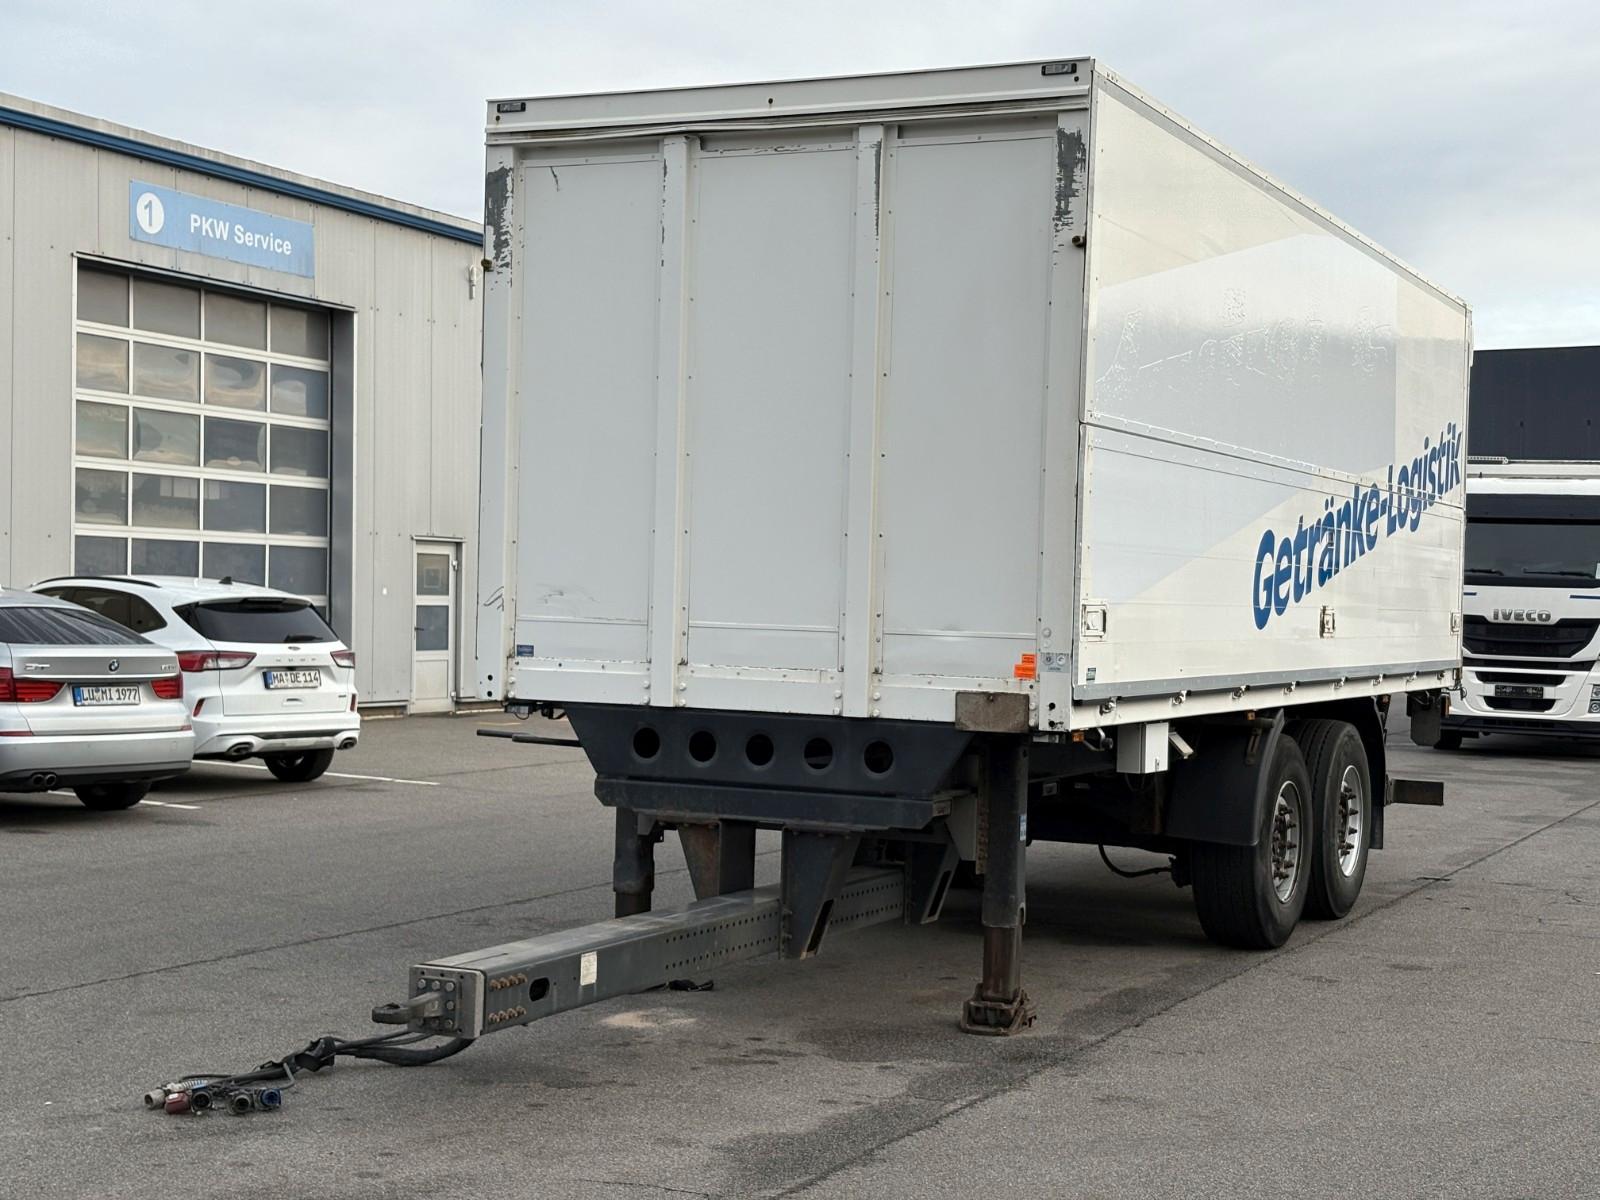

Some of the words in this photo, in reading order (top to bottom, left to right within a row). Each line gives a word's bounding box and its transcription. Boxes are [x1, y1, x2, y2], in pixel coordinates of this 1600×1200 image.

[143, 199, 153, 228] 1
[190, 213, 230, 241] PKW
[234, 225, 292, 255] Service
[1252, 422, 1462, 631] Getränke-Logistik
[1493, 608, 1552, 622] IVECO
[272, 671, 285, 683] MA
[290, 672, 301, 683] DE
[302, 672, 319, 683] 114
[81, 687, 95, 701] LU
[101, 687, 114, 701] MI
[115, 687, 138, 701] 1977
